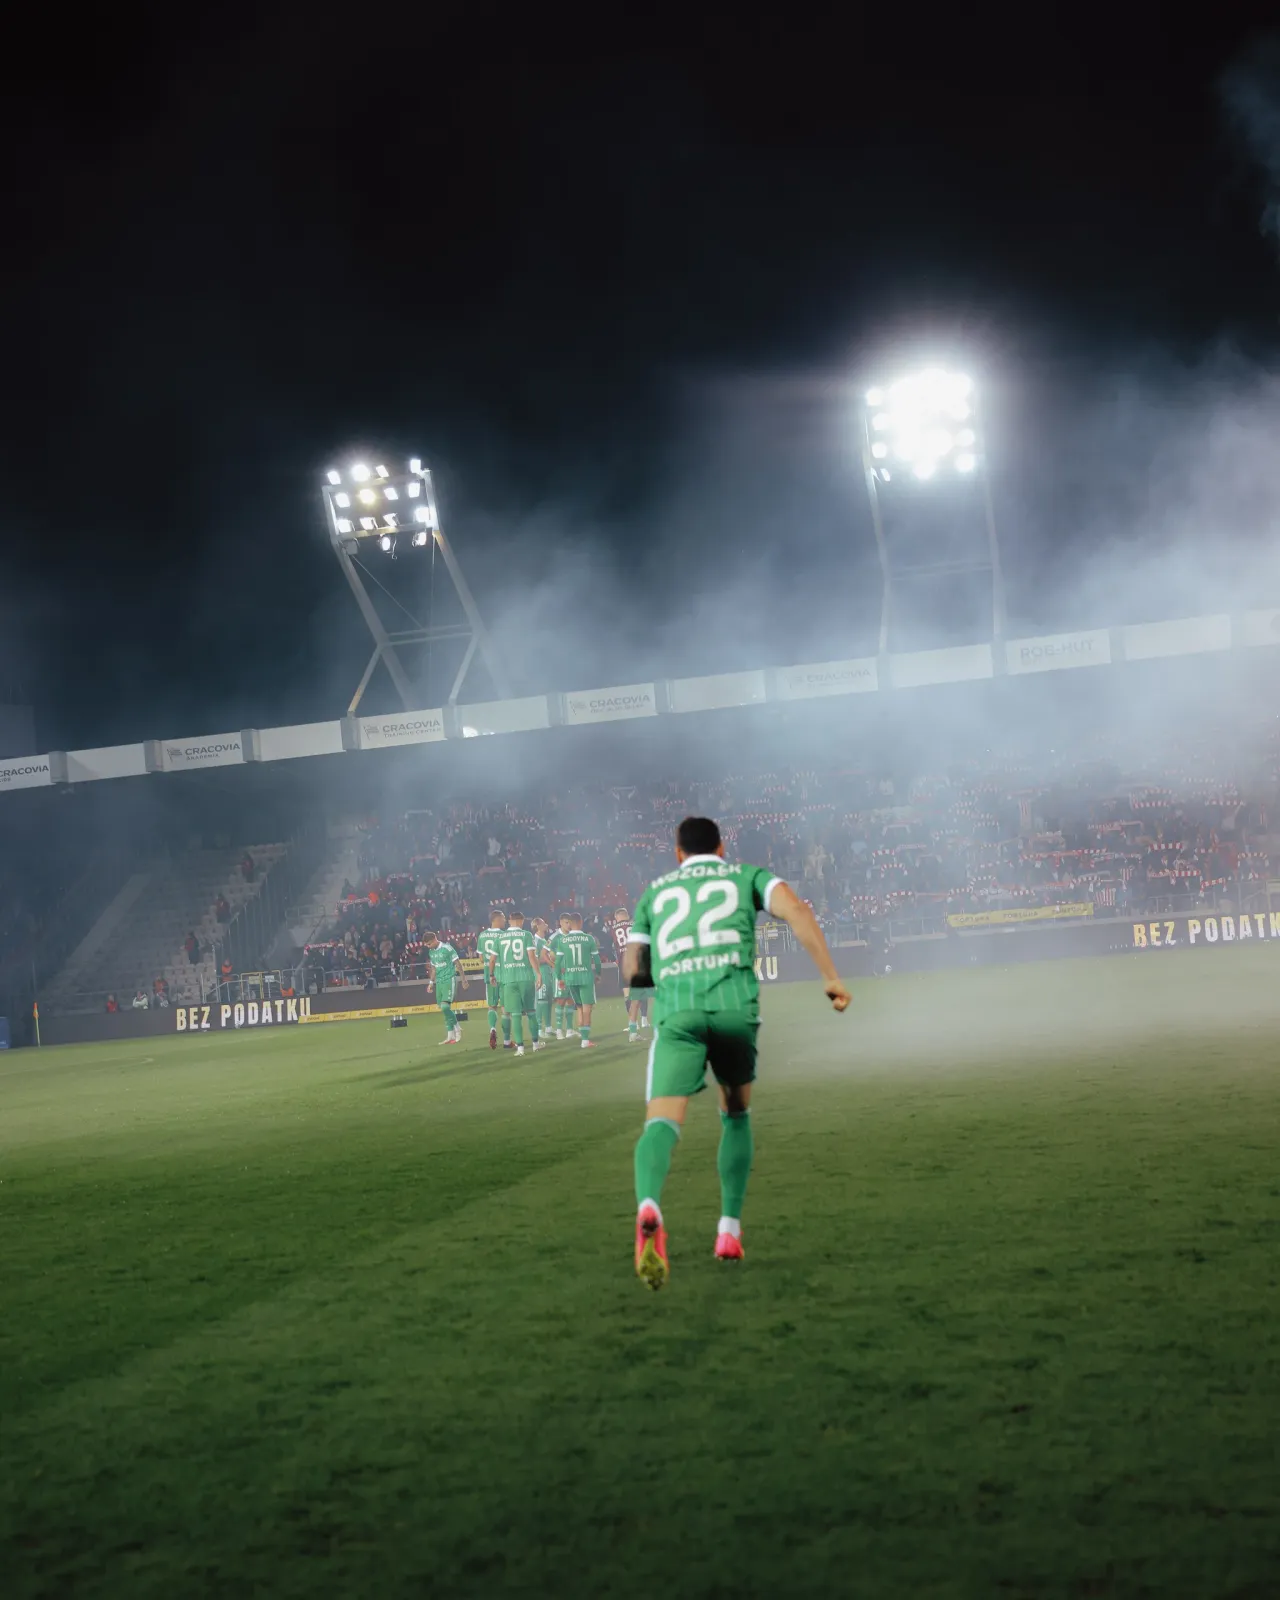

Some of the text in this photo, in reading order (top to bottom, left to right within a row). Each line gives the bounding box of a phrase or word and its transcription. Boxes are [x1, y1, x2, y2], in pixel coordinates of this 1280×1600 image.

[590, 694, 650, 708] CRACOVIA
[382, 719, 440, 733] CRACOVIA
[185, 743, 240, 756] CRACOVIA
[652, 879, 741, 961] 22
[1133, 921, 1177, 948] BEZ
[500, 938, 524, 962] 79
[568, 943, 582, 966] 11
[660, 951, 741, 981] FORTUNA
[176, 997, 311, 1031] BEZ PODATKU
